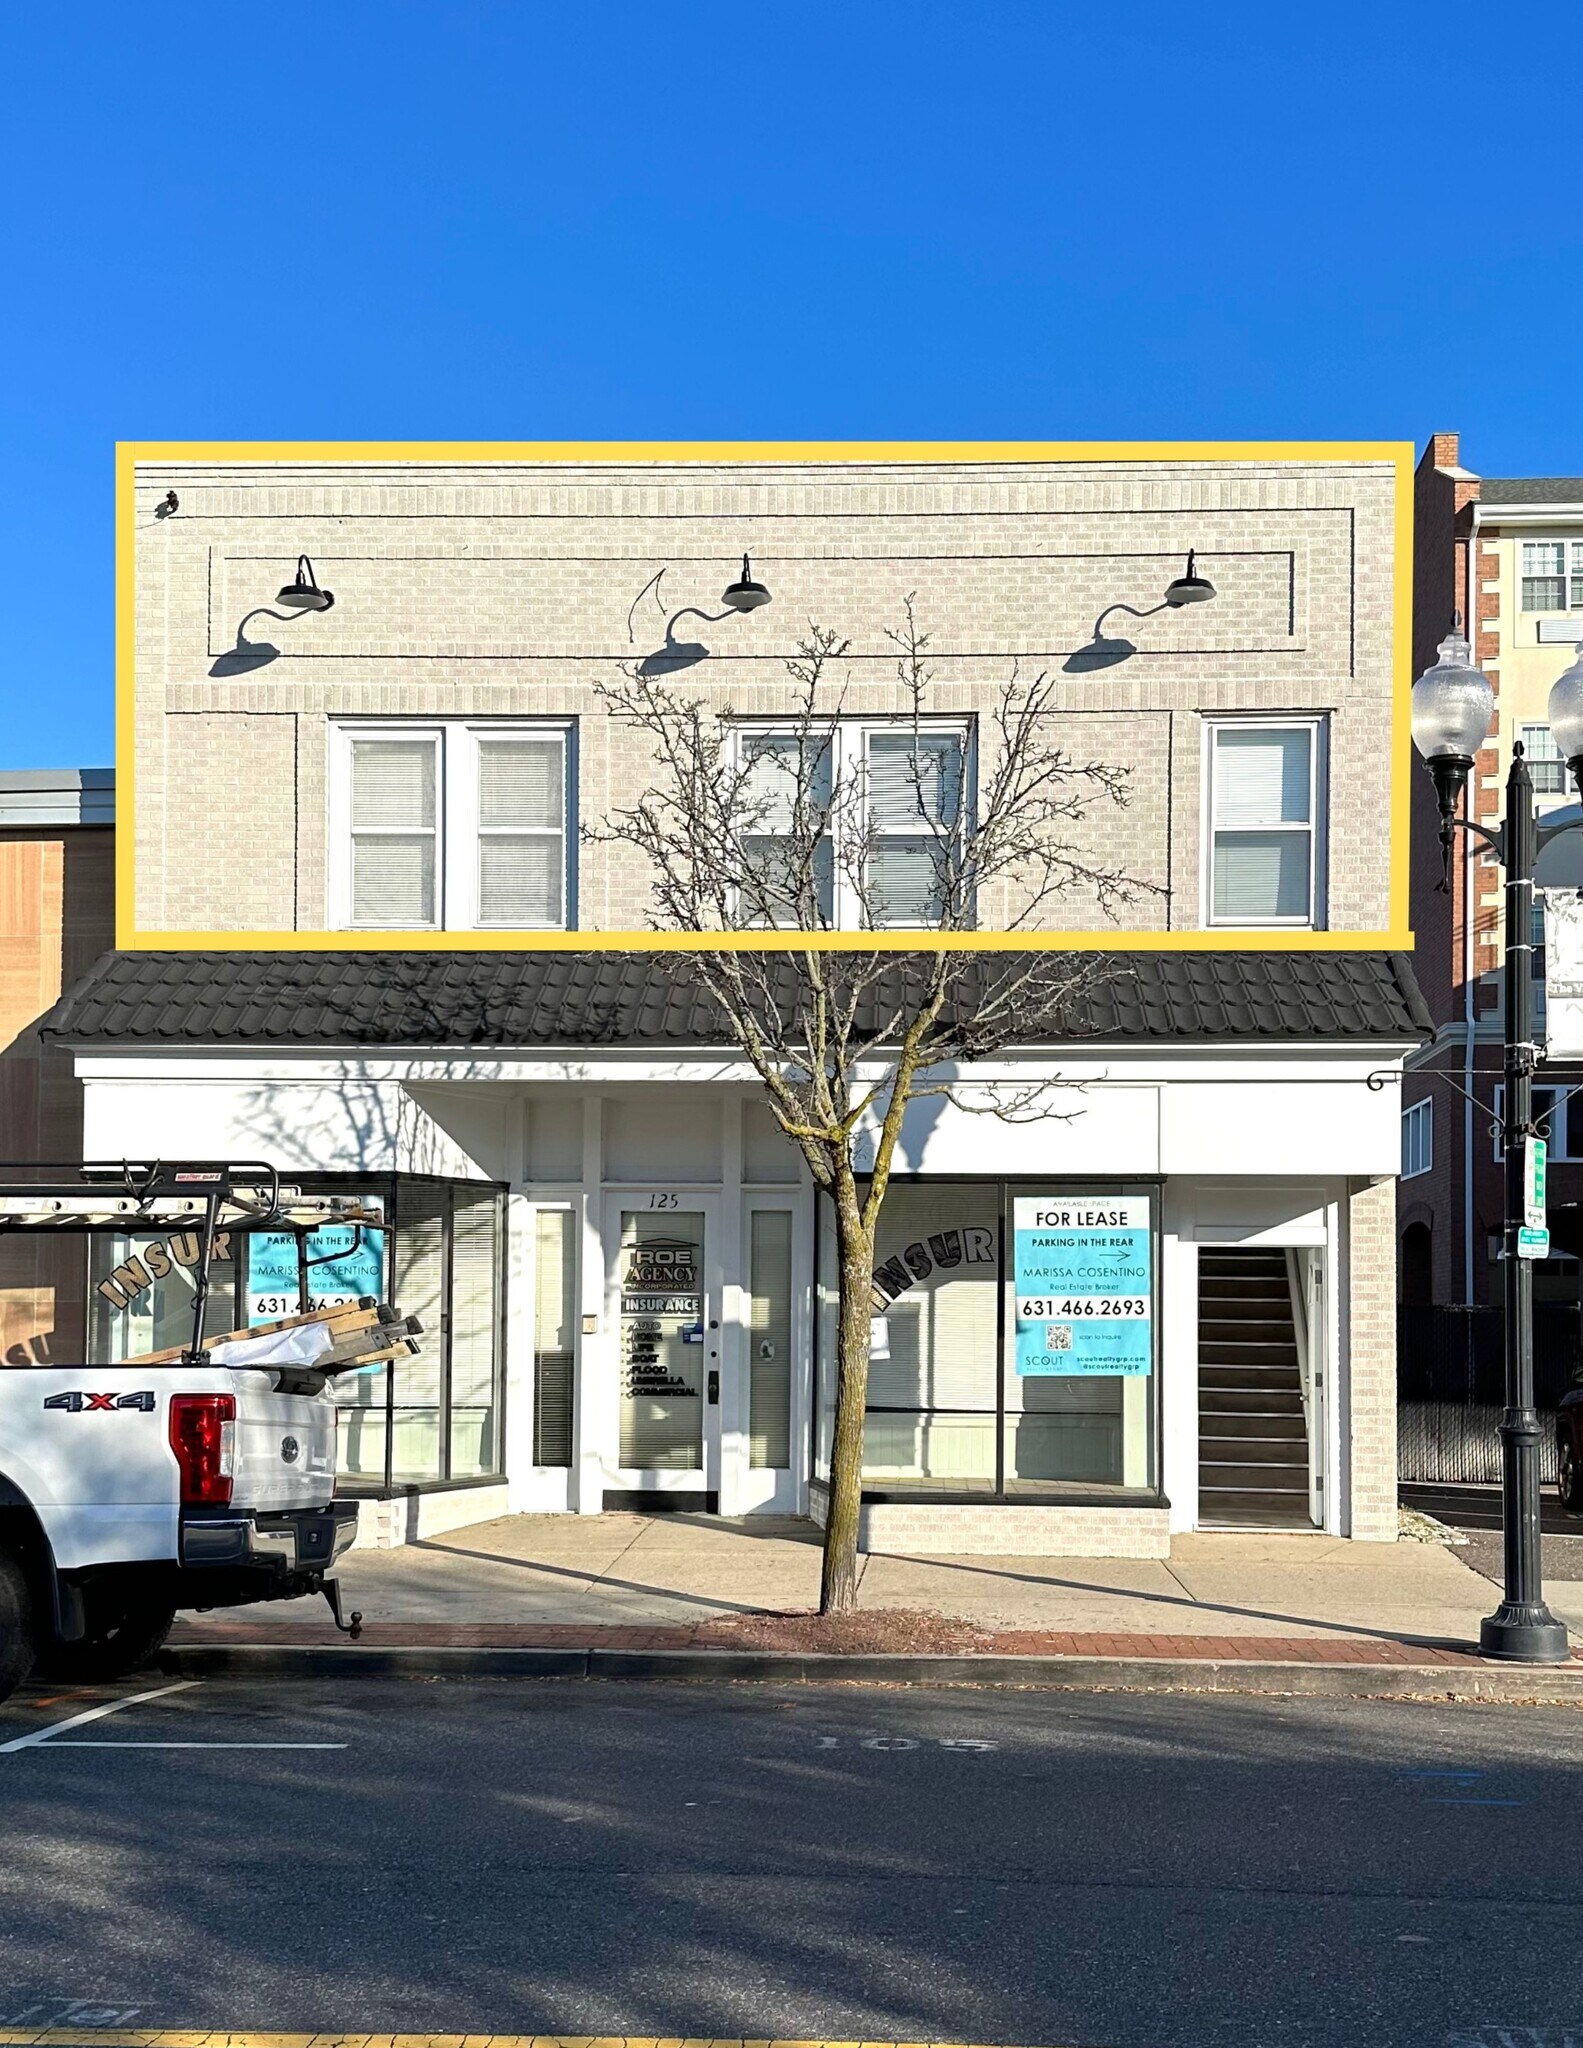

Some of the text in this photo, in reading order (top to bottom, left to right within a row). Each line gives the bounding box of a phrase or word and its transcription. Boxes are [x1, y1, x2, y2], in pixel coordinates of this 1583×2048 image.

[650, 1194, 678, 1208] 125
[1036, 1212, 1128, 1226] FOR LEASE
[267, 1237, 310, 1246] PARKIG
[314, 1237, 323, 1246] IN
[325, 1237, 342, 1245] THE
[1032, 1238, 1134, 1247] PARKING IN THE REAR
[635, 1250, 692, 1265] ROE
[98, 1231, 232, 1310] INSUR
[258, 1266, 380, 1276] MARISS COSENTINO
[629, 1266, 697, 1282] AGENCY
[870, 1227, 994, 1312] INSUR
[1023, 1267, 1146, 1277] MARISSA COSENTINO
[625, 1299, 699, 1311] INSURANCE
[1023, 1300, 1145, 1315] 631.466.2693
[633, 1321, 662, 1330] AUTO
[1026, 1356, 1063, 1365] SCOUT
[632, 1366, 668, 1374] FLOOD
